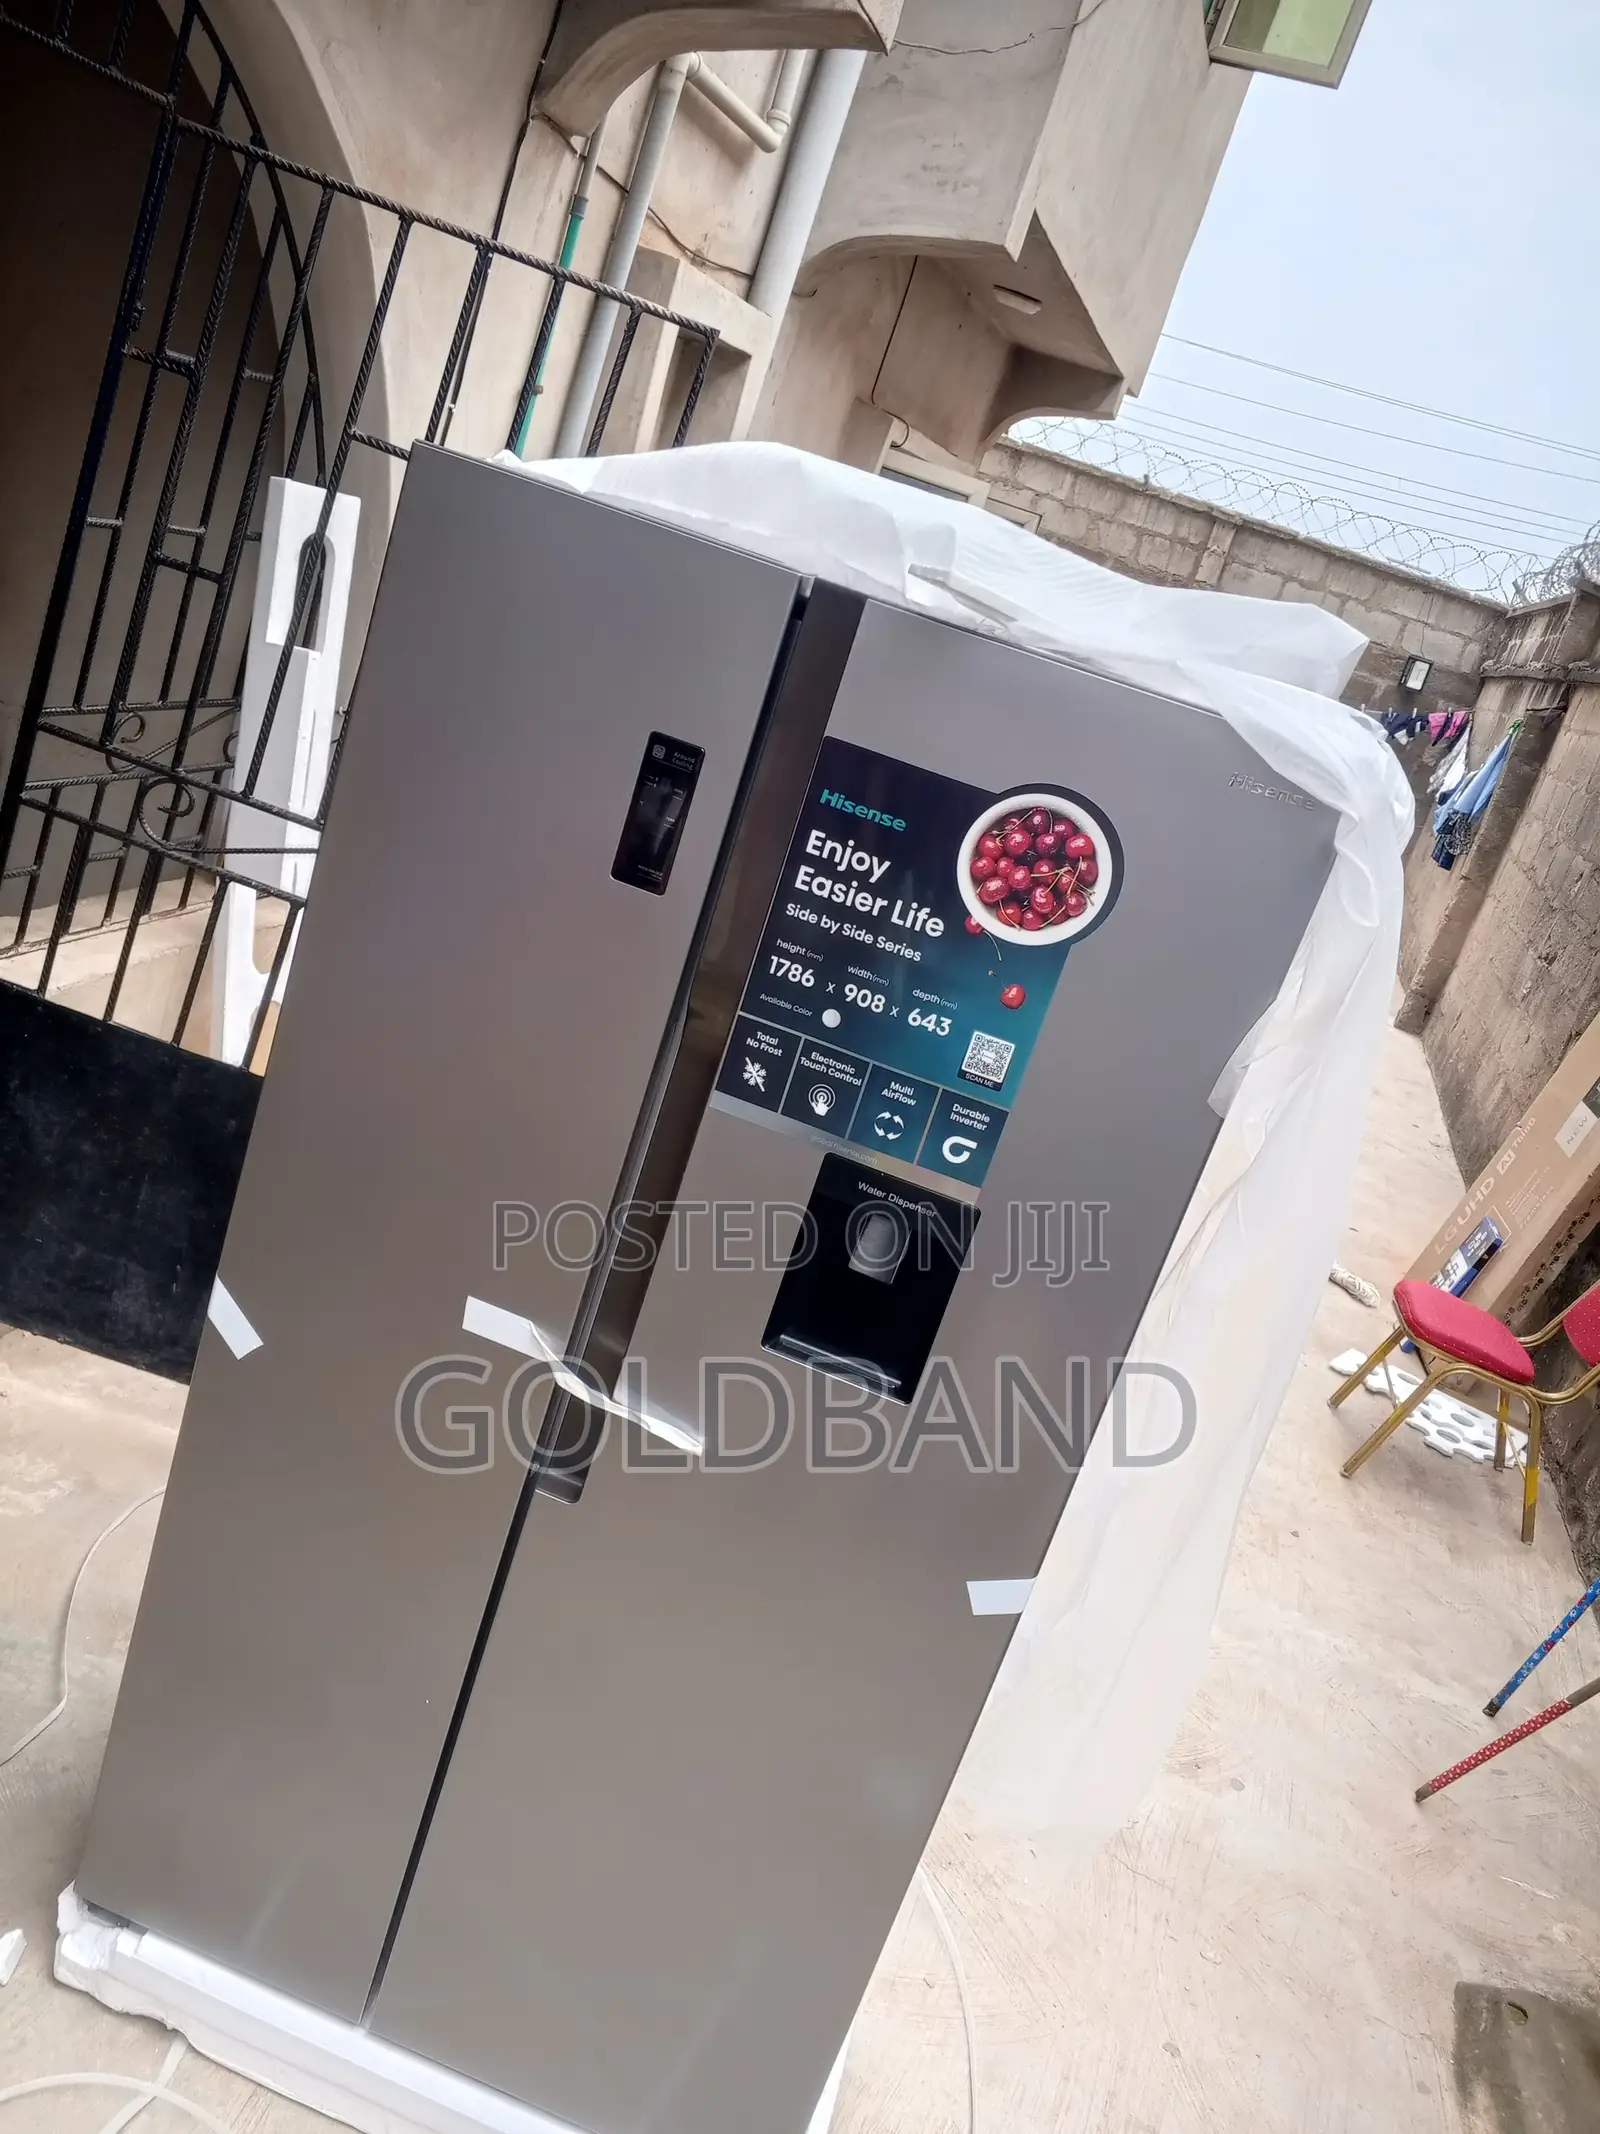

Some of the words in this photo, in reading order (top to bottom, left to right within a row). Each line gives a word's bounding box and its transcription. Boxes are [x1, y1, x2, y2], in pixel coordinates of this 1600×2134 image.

[1228, 771, 1315, 811] Hisense
[819, 788, 907, 831] Hisense
[805, 829, 891, 883] Enjoy
[794, 864, 888, 917] Easier
[890, 899, 945, 937] Life
[785, 903, 818, 924] Side
[820, 915, 841, 934] by
[841, 922, 874, 944] Side
[876, 935, 922, 962] Series
[759, 992, 793, 1010] Available
[792, 1004, 813, 1017] Color
[768, 955, 815, 988] 1786
[844, 983, 886, 1013] 908
[907, 1008, 952, 1037] 643
[745, 1037, 760, 1048] No
[759, 1042, 783, 1057] Frost
[756, 1031, 779, 1046] Total
[800, 1056, 828, 1074] Touch
[828, 1067, 863, 1087] Control
[810, 1051, 856, 1075] Electronic
[889, 1081, 915, 1095] Multi
[965, 1072, 984, 1084] SCAN
[983, 1078, 995, 1088] ME
[881, 1088, 917, 1106] AirFlow
[949, 1112, 988, 1131] Inverter
[952, 1103, 991, 1123] Durable
[857, 1180, 886, 1198] Water
[888, 1192, 937, 1218] Dispenser
[1434, 1223, 1459, 1256] LG
[1456, 1176, 1495, 1226] UHD
